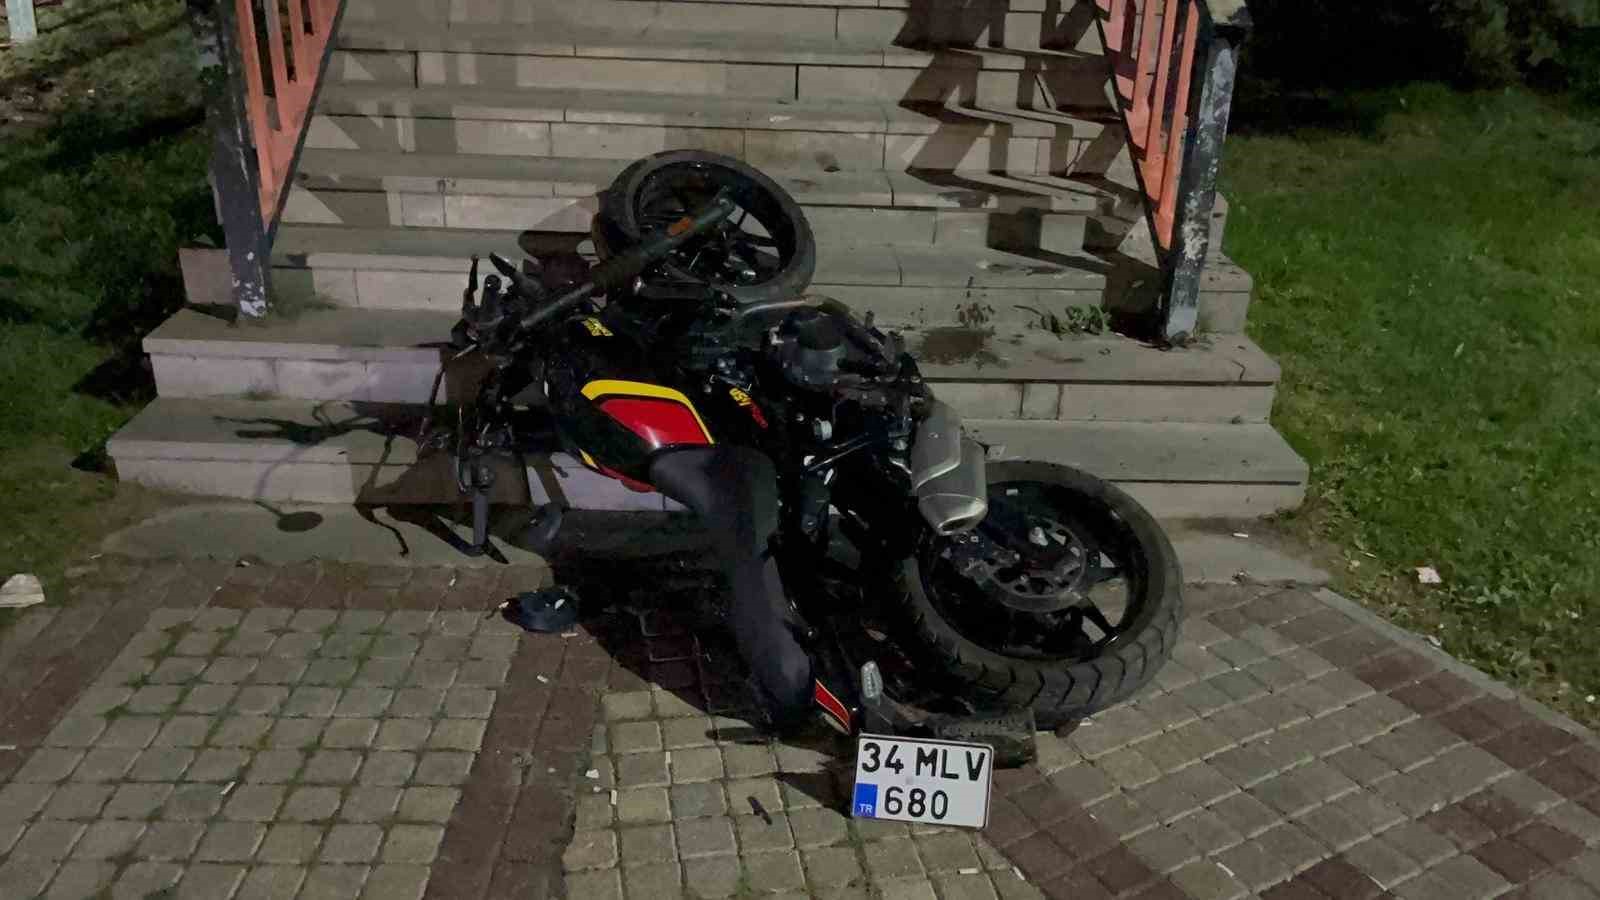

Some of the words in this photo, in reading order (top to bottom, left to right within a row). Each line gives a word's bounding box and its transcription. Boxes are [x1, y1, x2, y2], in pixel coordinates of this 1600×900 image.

[861, 742, 904, 774] 34
[915, 746, 986, 781] MLV
[859, 803, 873, 814] TR
[884, 786, 948, 820] 680
